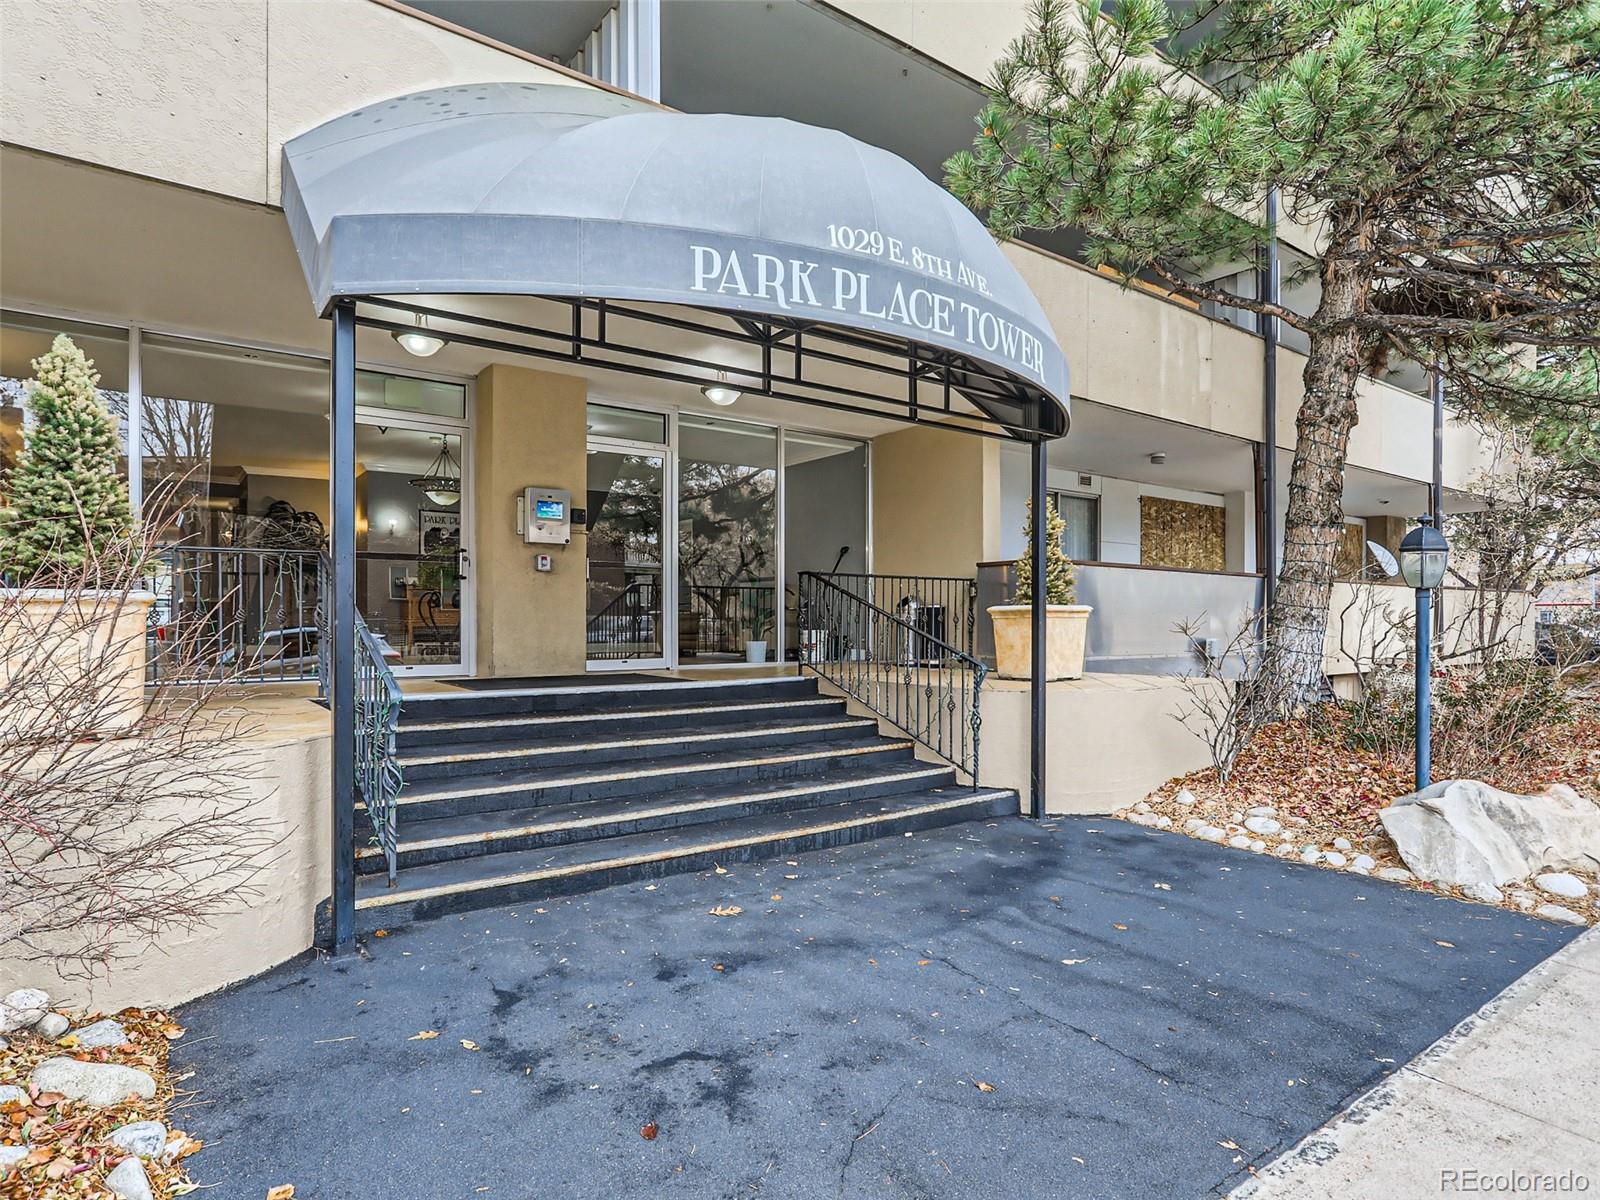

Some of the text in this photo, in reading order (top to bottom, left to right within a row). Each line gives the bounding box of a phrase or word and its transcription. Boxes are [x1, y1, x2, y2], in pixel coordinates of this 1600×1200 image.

[827, 223, 993, 298] 1029 E. 8TH AVE.
[690, 245, 1046, 384] PARK PLACE TOWER
